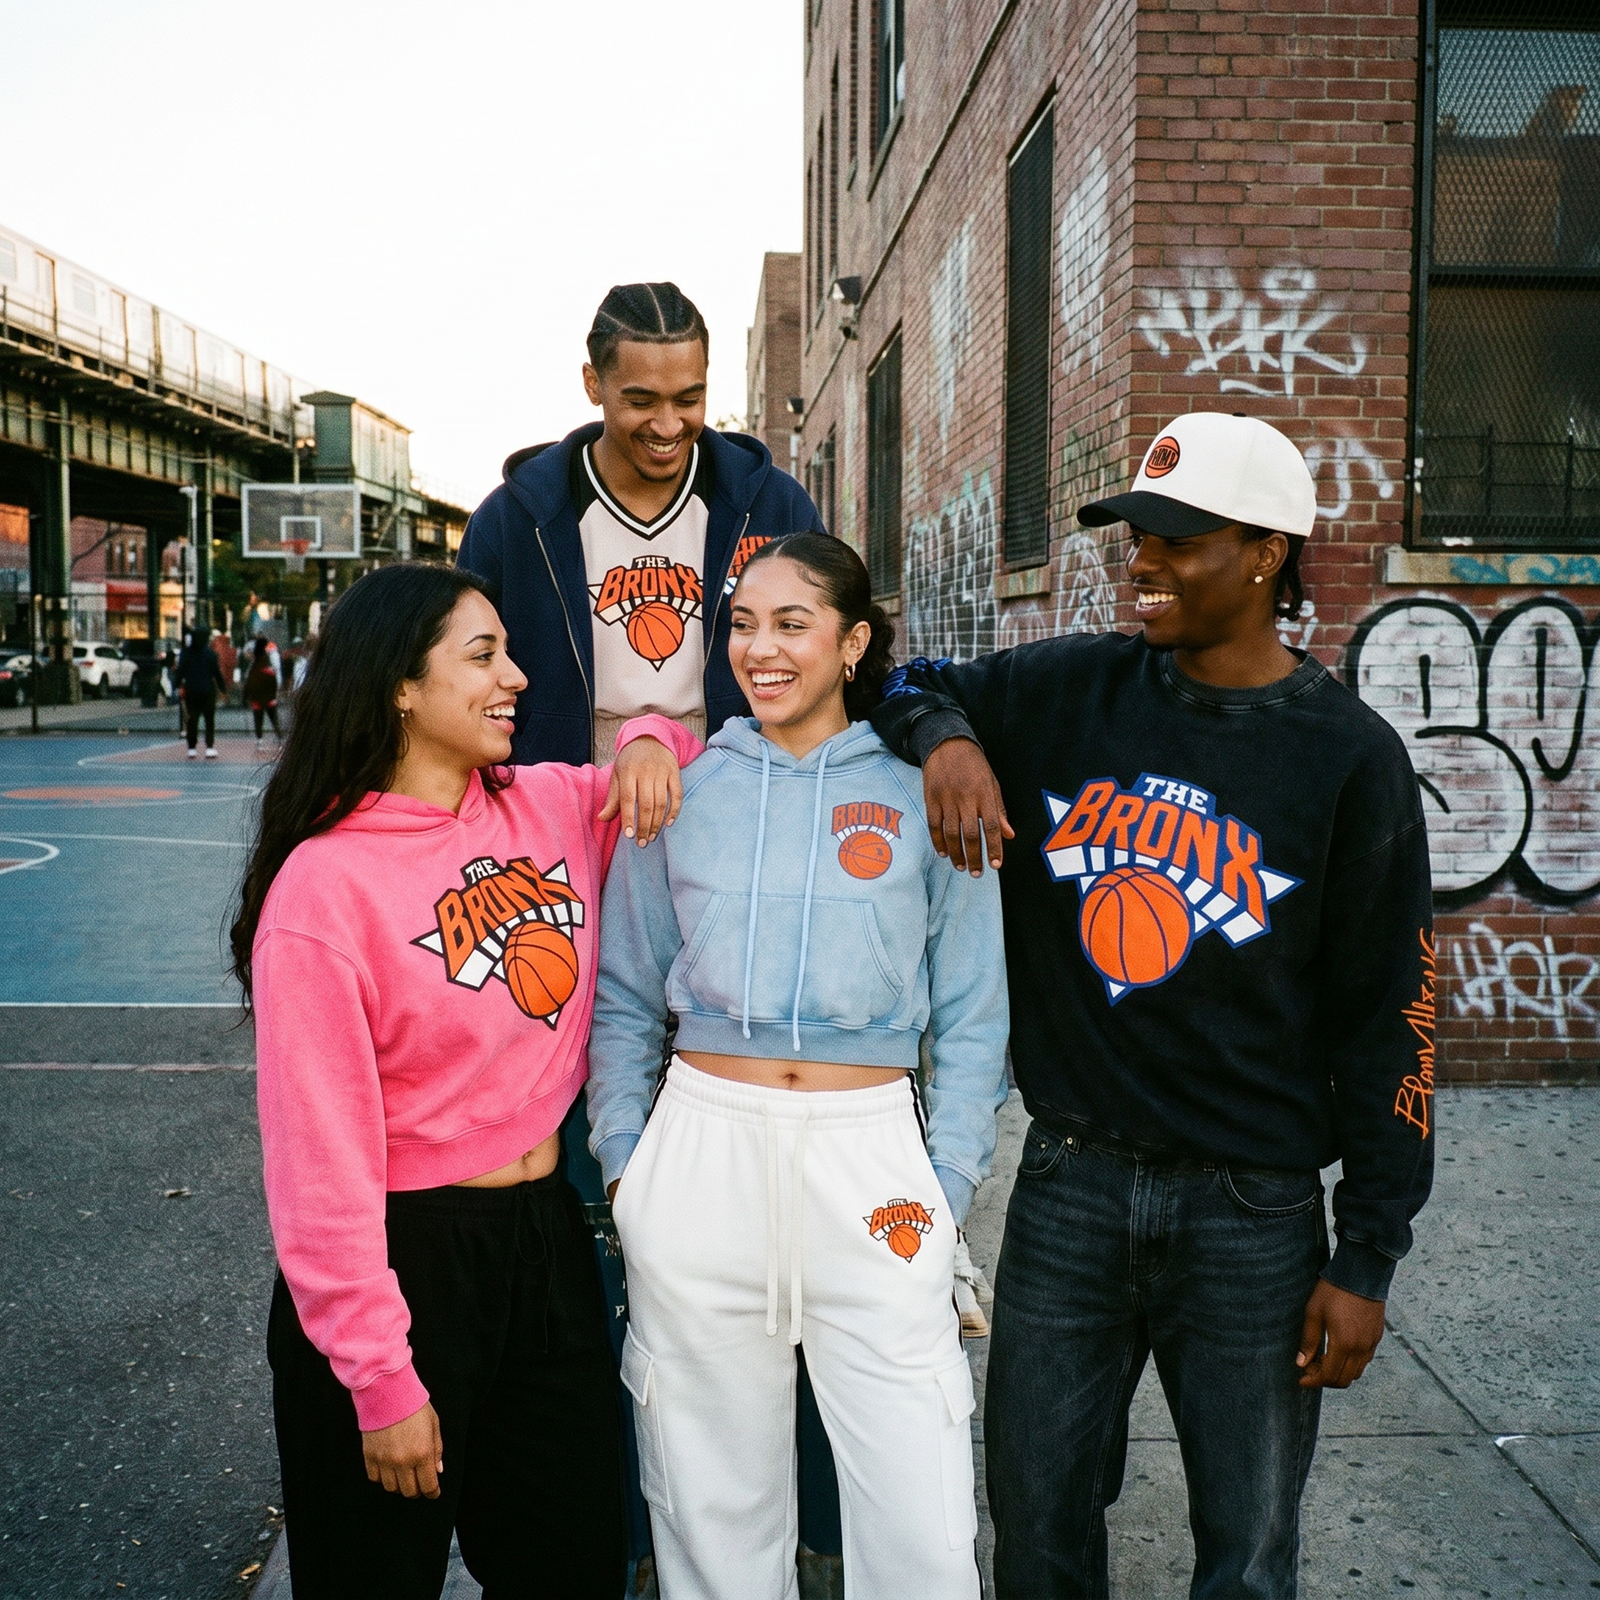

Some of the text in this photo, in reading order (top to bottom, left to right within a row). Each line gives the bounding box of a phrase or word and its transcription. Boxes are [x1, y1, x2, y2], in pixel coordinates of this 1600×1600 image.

[634, 556, 668, 568] THE
[595, 563, 704, 614] BRONX
[1142, 776, 1209, 815] THE
[832, 801, 903, 838] BRONX
[464, 858, 501, 885] THE
[1043, 781, 1267, 928] BRONX
[436, 858, 584, 980] BRONX
[869, 1201, 934, 1236] BRONX
